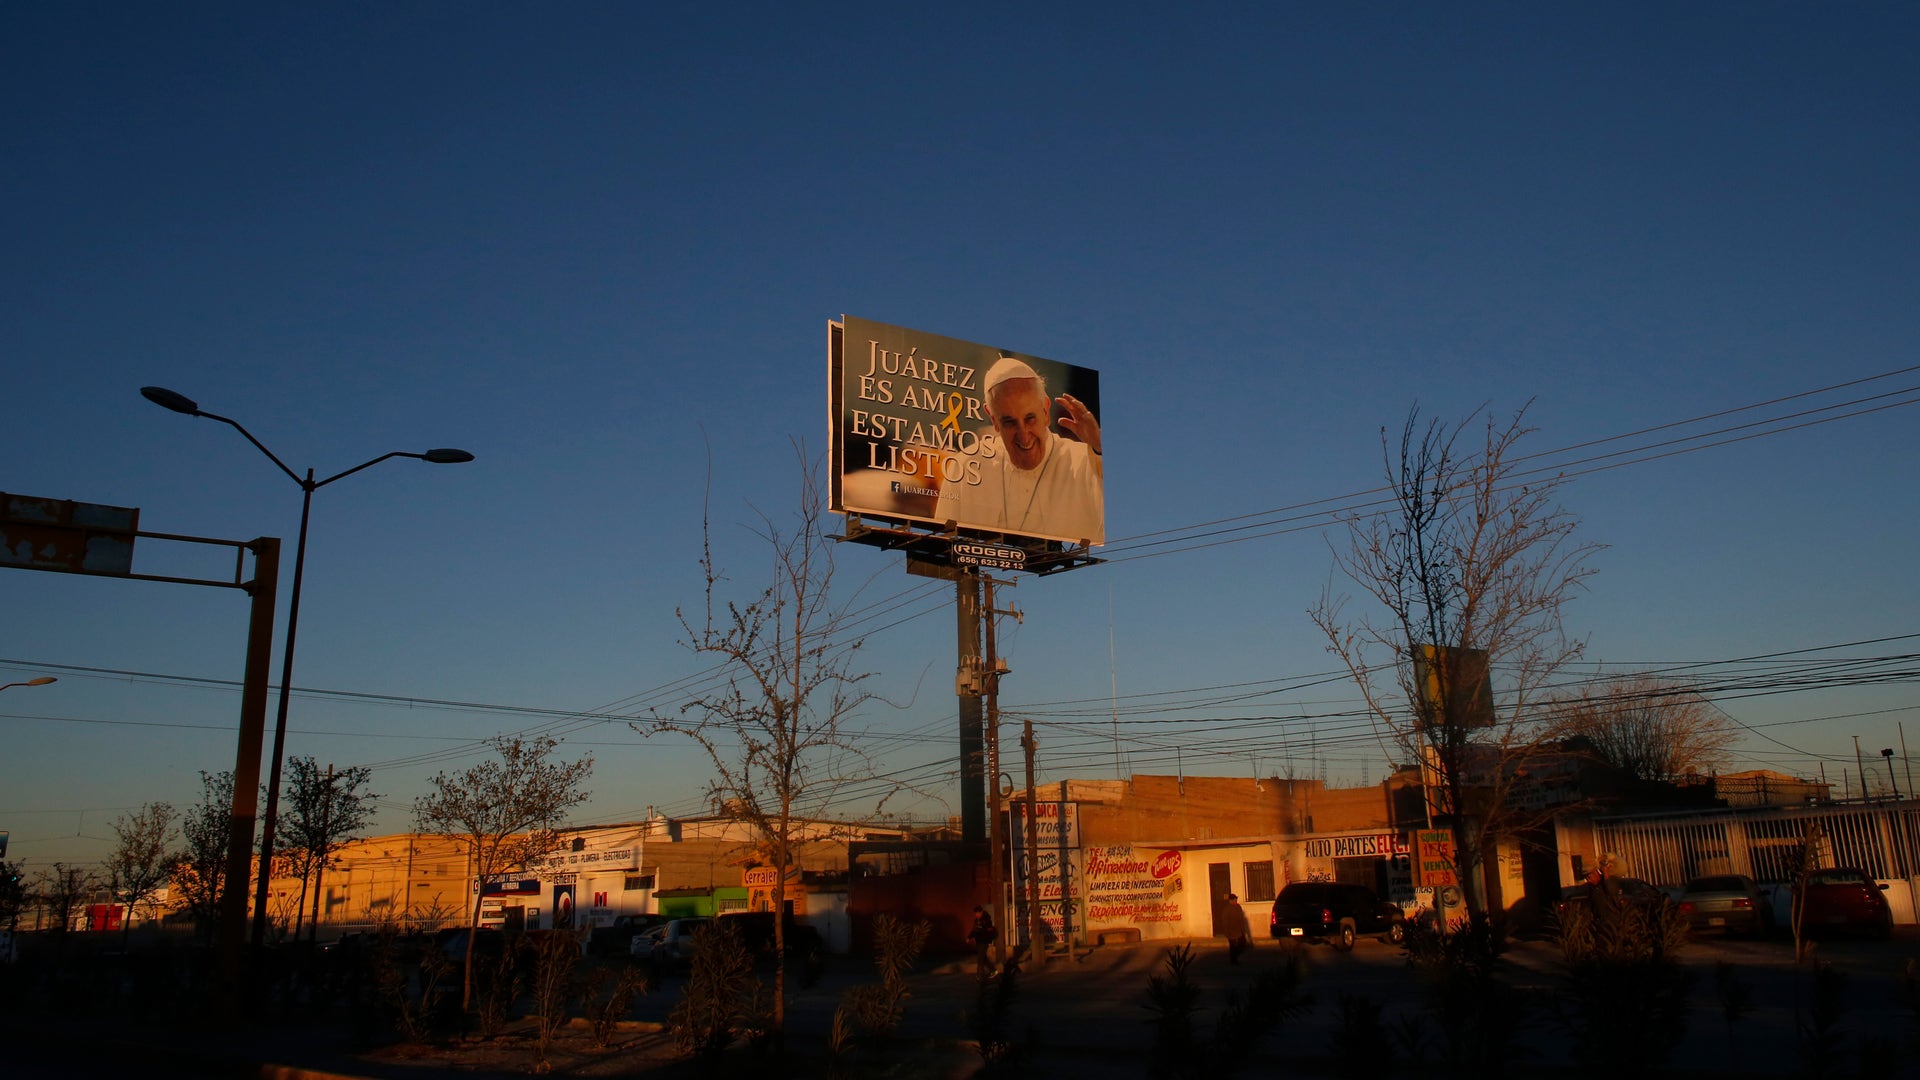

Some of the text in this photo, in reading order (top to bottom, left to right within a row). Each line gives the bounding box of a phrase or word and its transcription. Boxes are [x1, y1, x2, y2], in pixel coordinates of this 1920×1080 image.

[866, 340, 976, 390] JUÁREZ
[858, 375, 894, 404] ES
[850, 409, 996, 458] ESTAMOS
[867, 442, 983, 486] LISTOS
[957, 545, 1022, 560] ROGER
[957, 556, 979, 565] (656)
[1305, 840, 1331, 857] AUTO
[1335, 837, 1376, 856] PARTES
[1424, 861, 1451, 871] VENTA
[1090, 881, 1120, 890] LIMPIEZA
[1121, 881, 1130, 889] DE
